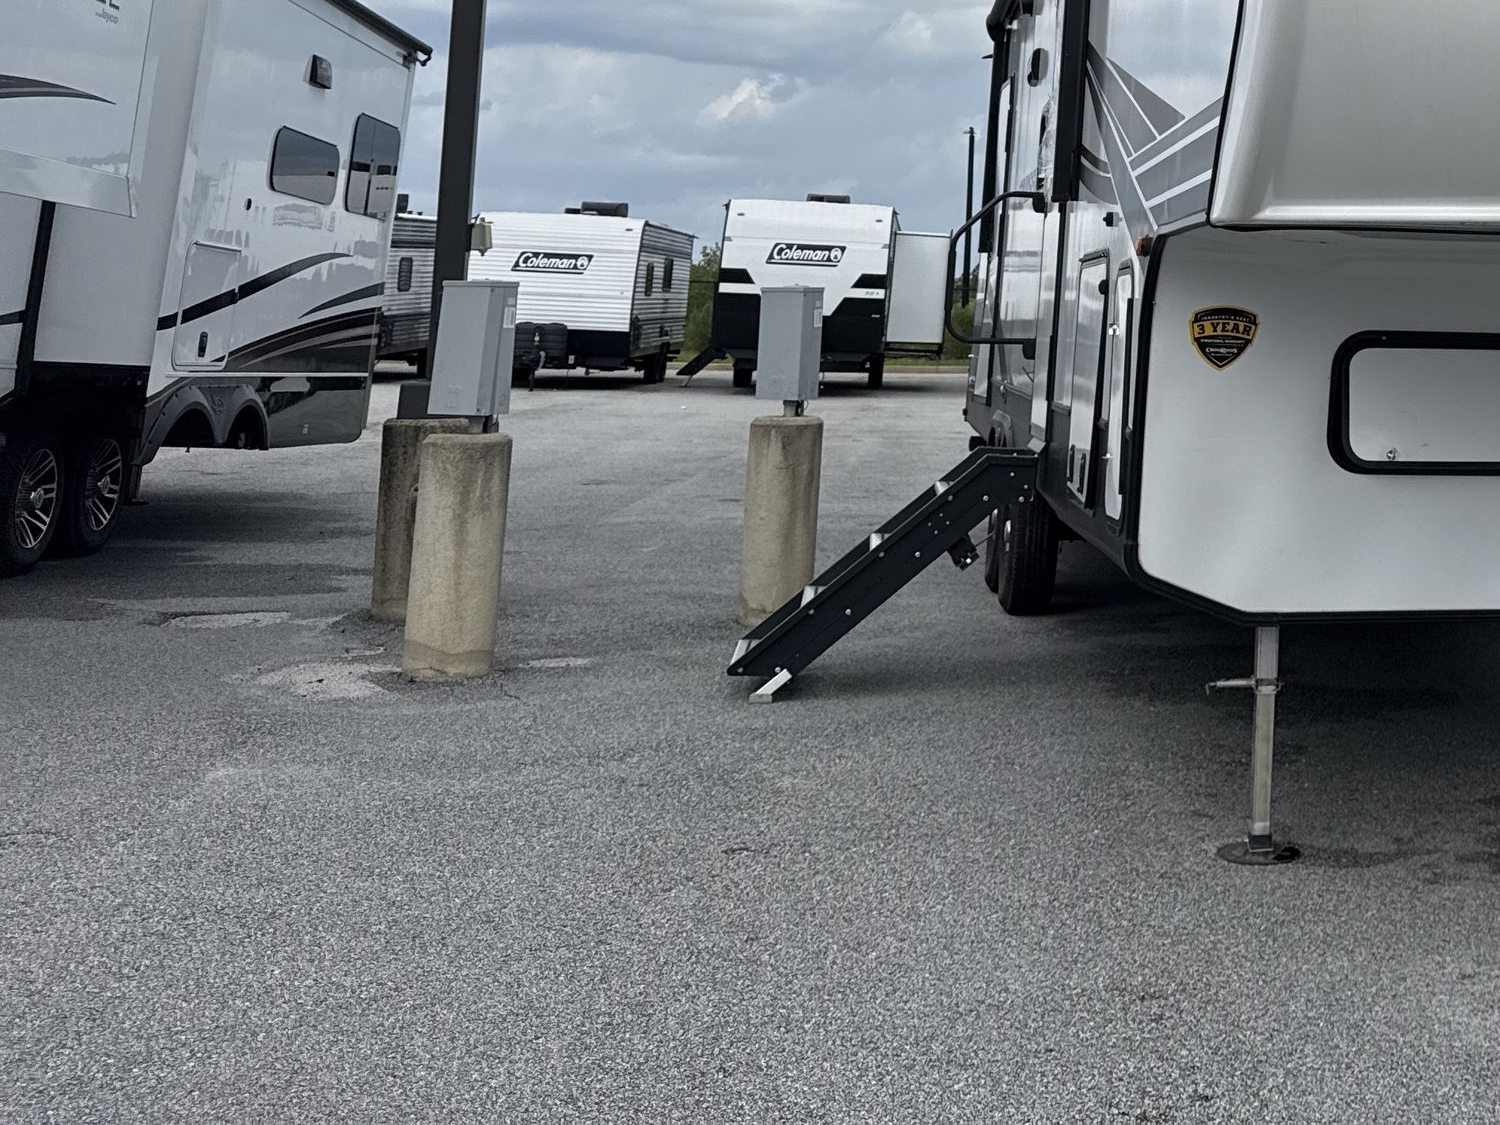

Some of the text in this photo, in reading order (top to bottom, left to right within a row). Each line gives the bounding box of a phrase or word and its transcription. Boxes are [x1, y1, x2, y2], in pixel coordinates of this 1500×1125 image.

[518, 252, 577, 270] Coleman
[773, 243, 830, 261] Coleman
[1197, 322, 1252, 336] 3 YEAR
